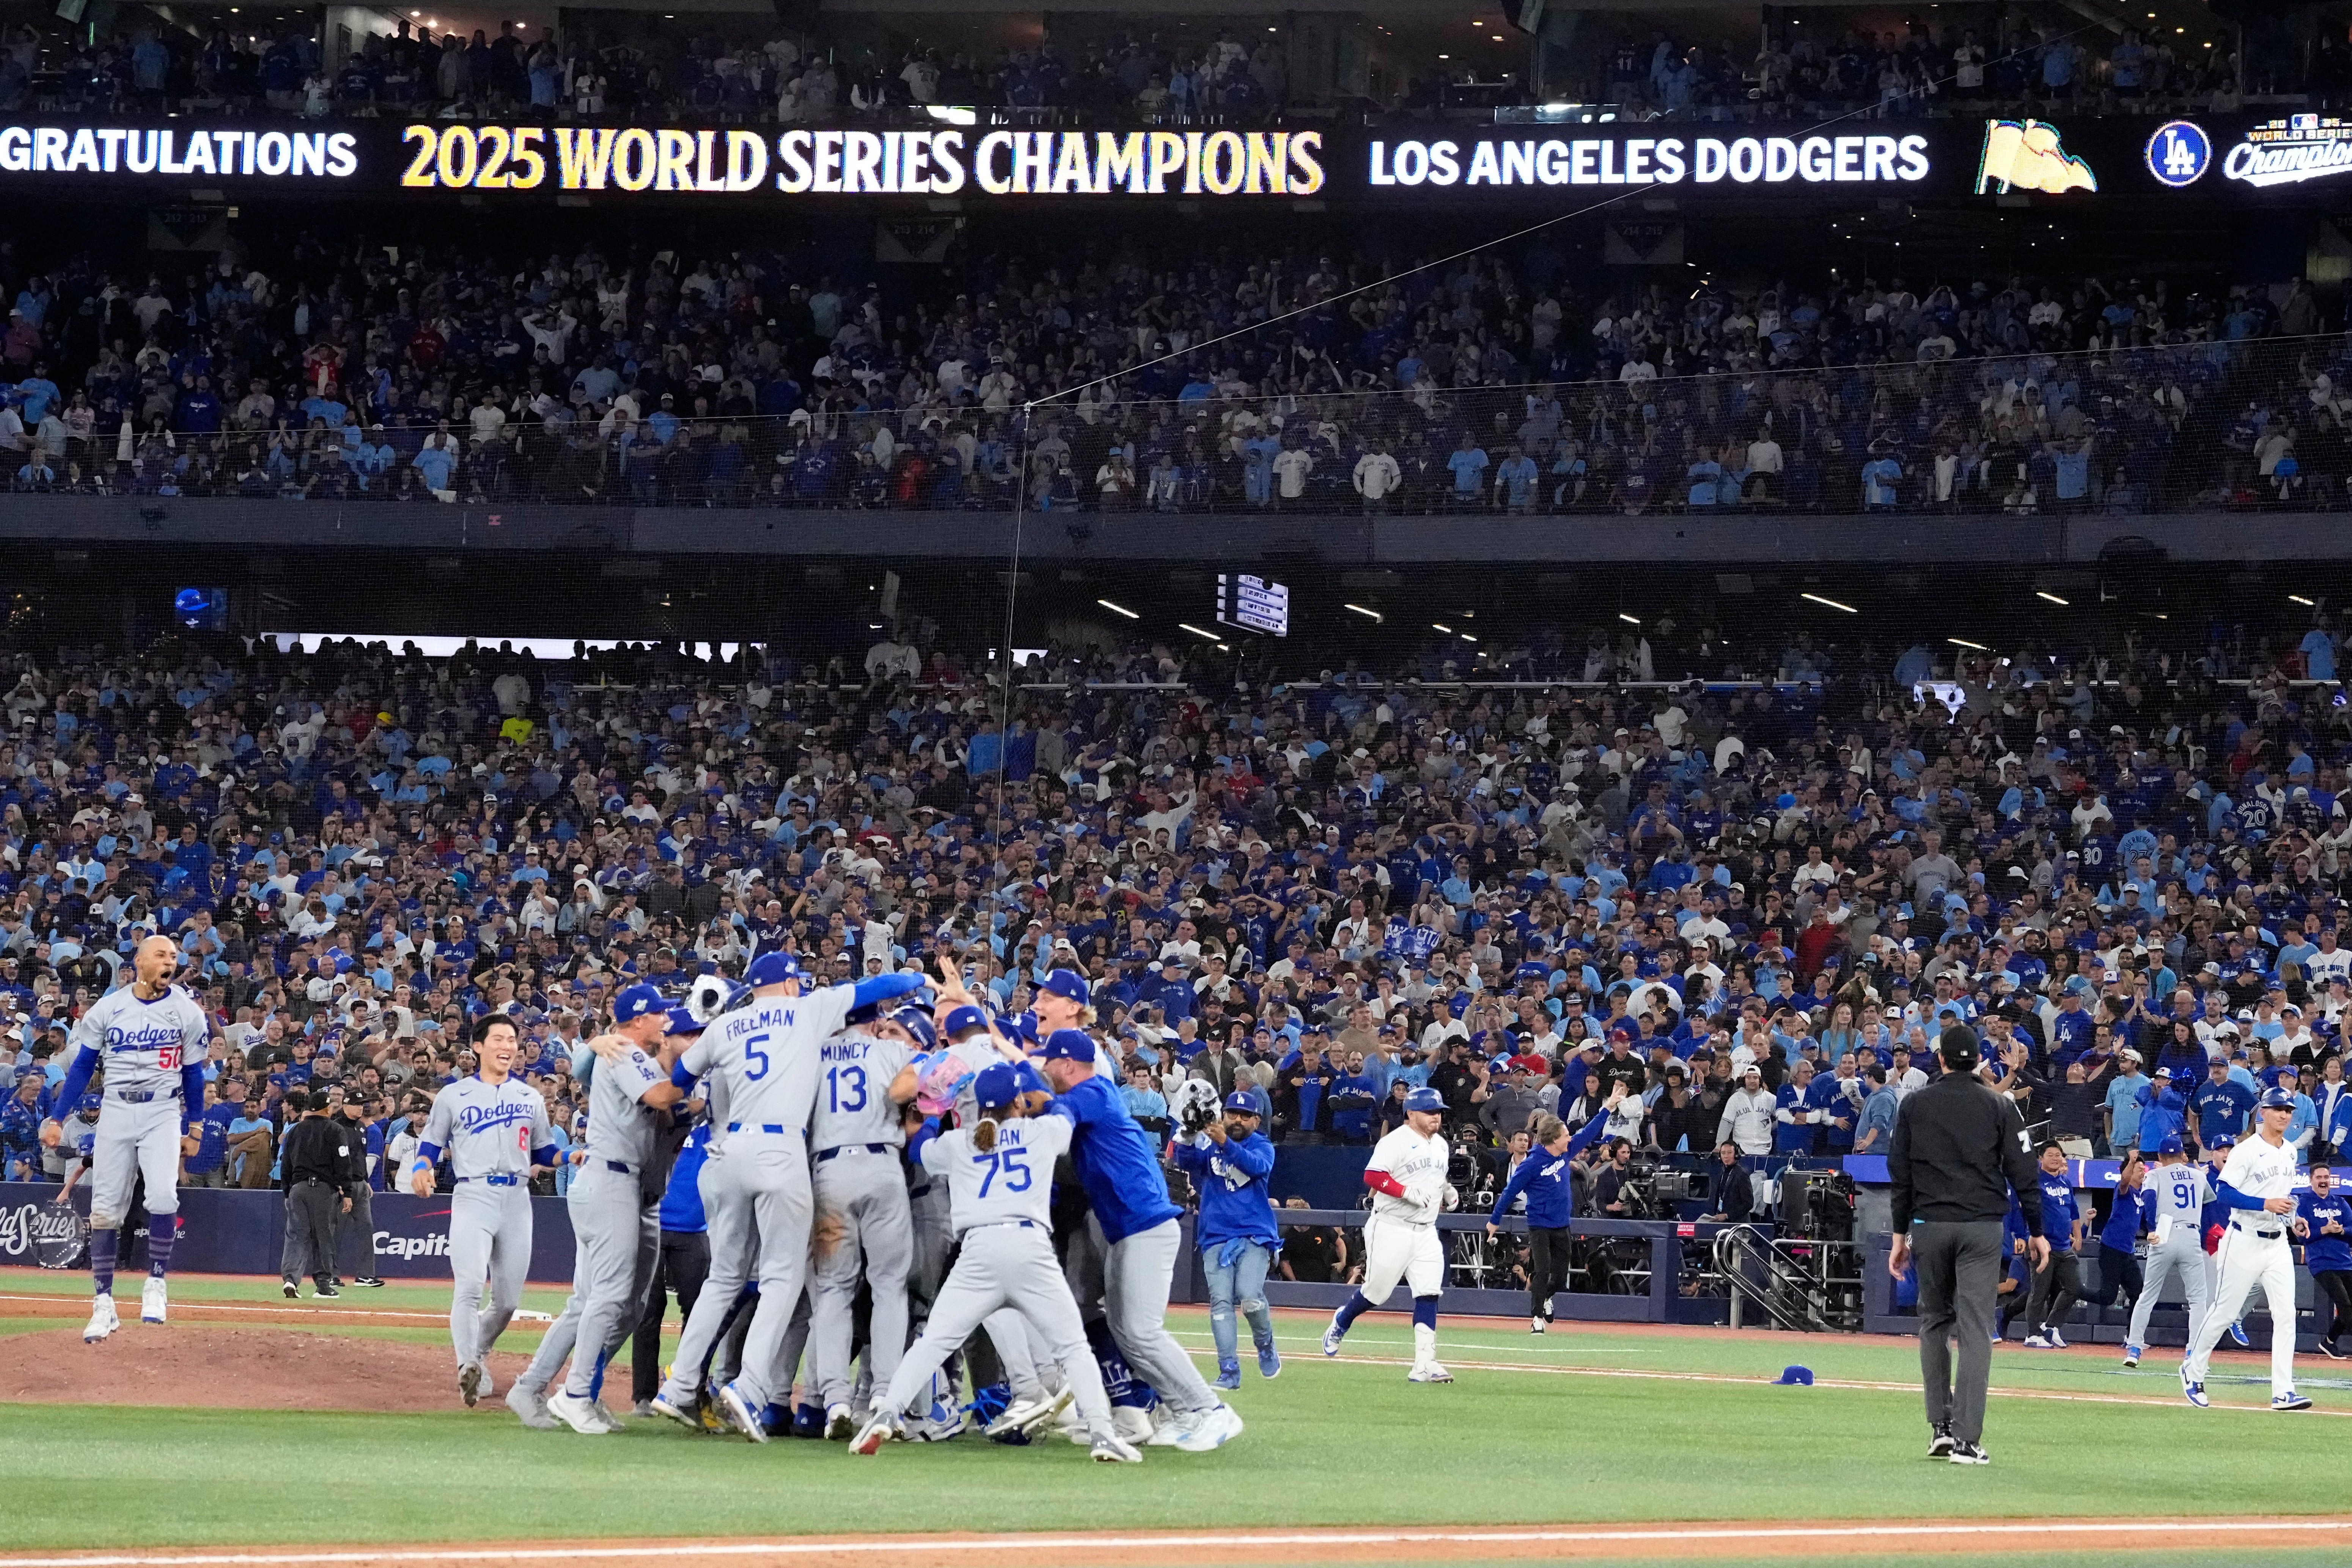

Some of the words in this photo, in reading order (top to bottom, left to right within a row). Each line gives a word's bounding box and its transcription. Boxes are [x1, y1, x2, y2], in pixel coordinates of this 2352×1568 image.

[2267, 120, 2286, 129] 20
[2322, 118, 2341, 127] 25
[2248, 129, 2303, 141] WORLD
[2306, 127, 2352, 141] SERIE
[0, 127, 358, 176] GRATULATIONS
[400, 125, 546, 189] 2025
[553, 128, 769, 191] WORLD
[776, 130, 966, 194] SERIES
[973, 131, 1325, 195] CHAMPIONS
[1369, 141, 1461, 185] LOS
[1465, 138, 1687, 185] ANGELES
[1693, 135, 1930, 182] DODGERS
[2163, 129, 2195, 175] LA
[2223, 140, 2352, 179] Champio
[495, 822, 502, 832] LA
[2244, 809, 2266, 828] 20
[2083, 847, 2102, 865] 30
[1611, 880, 1628, 888] BAUTIS
[2311, 965, 2325, 974] BLUE
[2327, 965, 2344, 974] JAYS
[318, 983, 331, 992] BLUE
[725, 1009, 795, 1042] FREEMAN
[2060, 1023, 2072, 1042] LA
[107, 1024, 182, 1051] Dodgers
[244, 1033, 267, 1046] Dodge
[158, 1046, 182, 1070] 50
[745, 1034, 769, 1081] 5
[821, 1043, 870, 1063] MUNCY
[635, 1066, 657, 1081] LA
[1608, 1068, 1633, 1077] Dodgers
[827, 1066, 866, 1113] 13
[1339, 1087, 1349, 1095] LUE
[1351, 1087, 1362, 1097] JAY
[1236, 1094, 1245, 1105] LA
[1788, 1101, 1800, 1109] LUE
[2215, 1095, 2234, 1107] JAYS
[460, 1100, 533, 1132] Dodgers
[1736, 1106, 1750, 1117] BLUE
[1755, 1105, 1771, 1116] JAYS
[207, 1119, 223, 1128] JAYS
[994, 1129, 1020, 1146] AN
[2017, 1130, 2031, 1153] 7
[972, 1148, 1032, 1199] 75
[1406, 1158, 1432, 1175] BLUE
[1435, 1159, 1448, 1169] JA
[2254, 1166, 2278, 1184] BLUE
[2170, 1171, 2194, 1181] EBEL
[2173, 1184, 2196, 1209] 91
